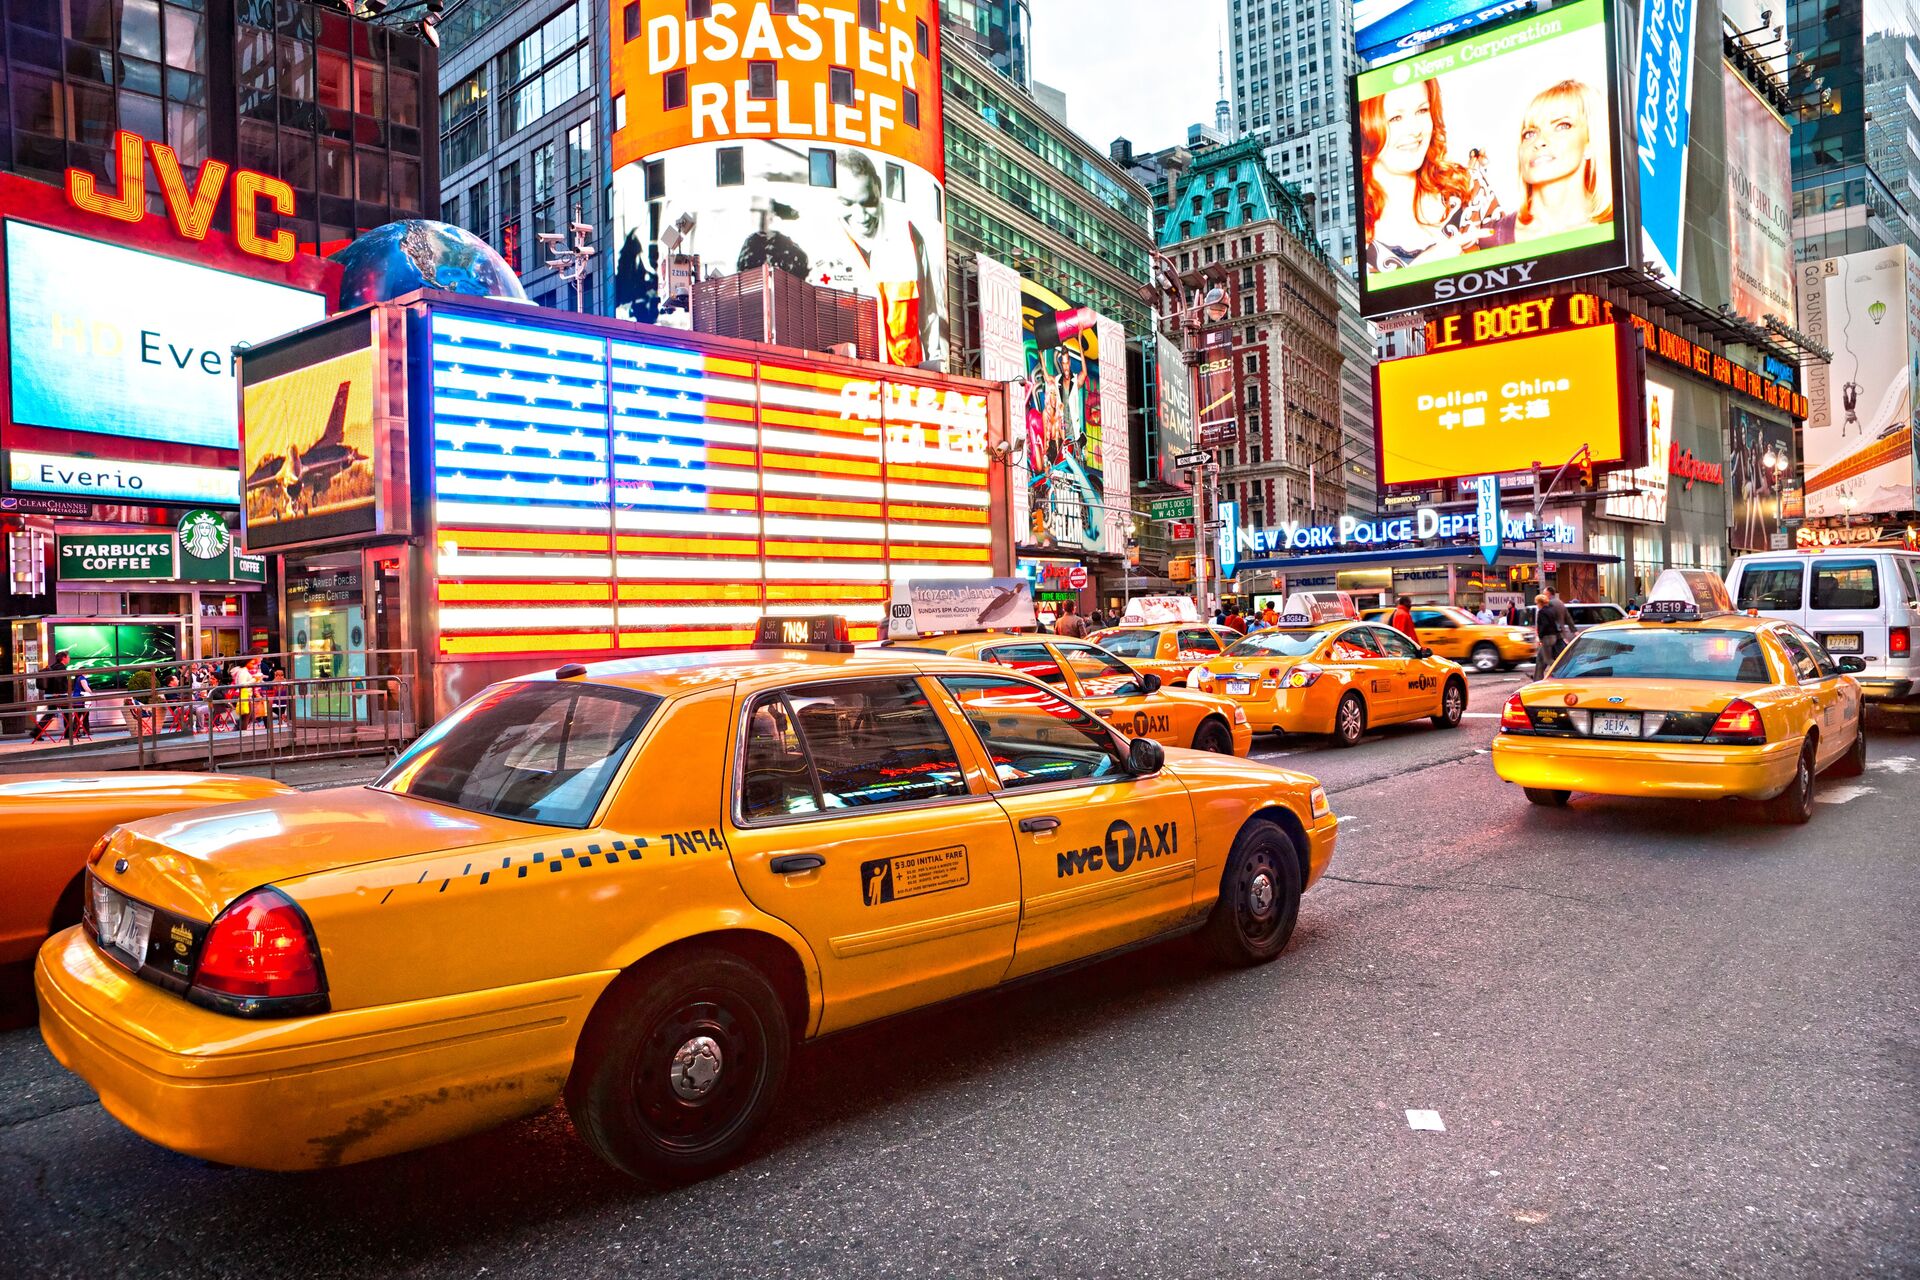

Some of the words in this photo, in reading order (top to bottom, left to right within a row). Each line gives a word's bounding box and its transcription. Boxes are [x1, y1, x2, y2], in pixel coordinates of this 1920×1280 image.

[648, 2, 916, 89] DISASTER
[1413, 53, 1455, 79] News
[1460, 17, 1562, 62] Corporation
[691, 79, 897, 147] RELIEF
[1638, 52, 1661, 176] Most
[65, 129, 297, 263] JVC
[1825, 261, 1835, 274] 8
[1434, 260, 1538, 300] SONY
[1378, 319, 1422, 332] SHERWOOD
[1472, 297, 1554, 341] BOGEY
[1806, 291, 1825, 346] BUNGE
[1809, 356, 1827, 424] UMPING
[40, 464, 144, 490] Everio
[1483, 479, 1494, 543] NYPD
[1236, 524, 1278, 553] NEW
[1280, 520, 1334, 550] YORK
[1340, 515, 1412, 546] POLICE
[1417, 508, 1475, 540] DEPT
[1500, 509, 1525, 540] YORK
[1554, 515, 1576, 544] DEPT
[1796, 526, 1884, 543] Subway
[62, 544, 170, 557] STARBUCKS
[82, 557, 151, 570] COFFEE
[239, 560, 260, 573] COFFEE
[313, 576, 332, 588] ARMED
[333, 574, 357, 587] FORCES
[1295, 577, 1327, 586] POLICE
[1403, 571, 1438, 580] POLICE
[303, 592, 326, 603] CAREER
[326, 589, 350, 601] CENTER
[915, 586, 956, 601] frozen
[958, 586, 995, 603] planet
[1656, 602, 1681, 613] 3E19
[764, 631, 778, 640] DUTY
[813, 631, 828, 640] DUTY
[767, 621, 776, 629] OFF
[782, 621, 809, 643] 7N94
[816, 621, 826, 629] OFF
[1135, 712, 1170, 735] TAXI
[661, 828, 724, 856] 7N94
[1057, 845, 1104, 878] NYC
[1107, 820, 1178, 870] TAXI
[894, 858, 916, 870] $3.00
[916, 854, 943, 866] INITIAL
[945, 850, 963, 860] FARE
